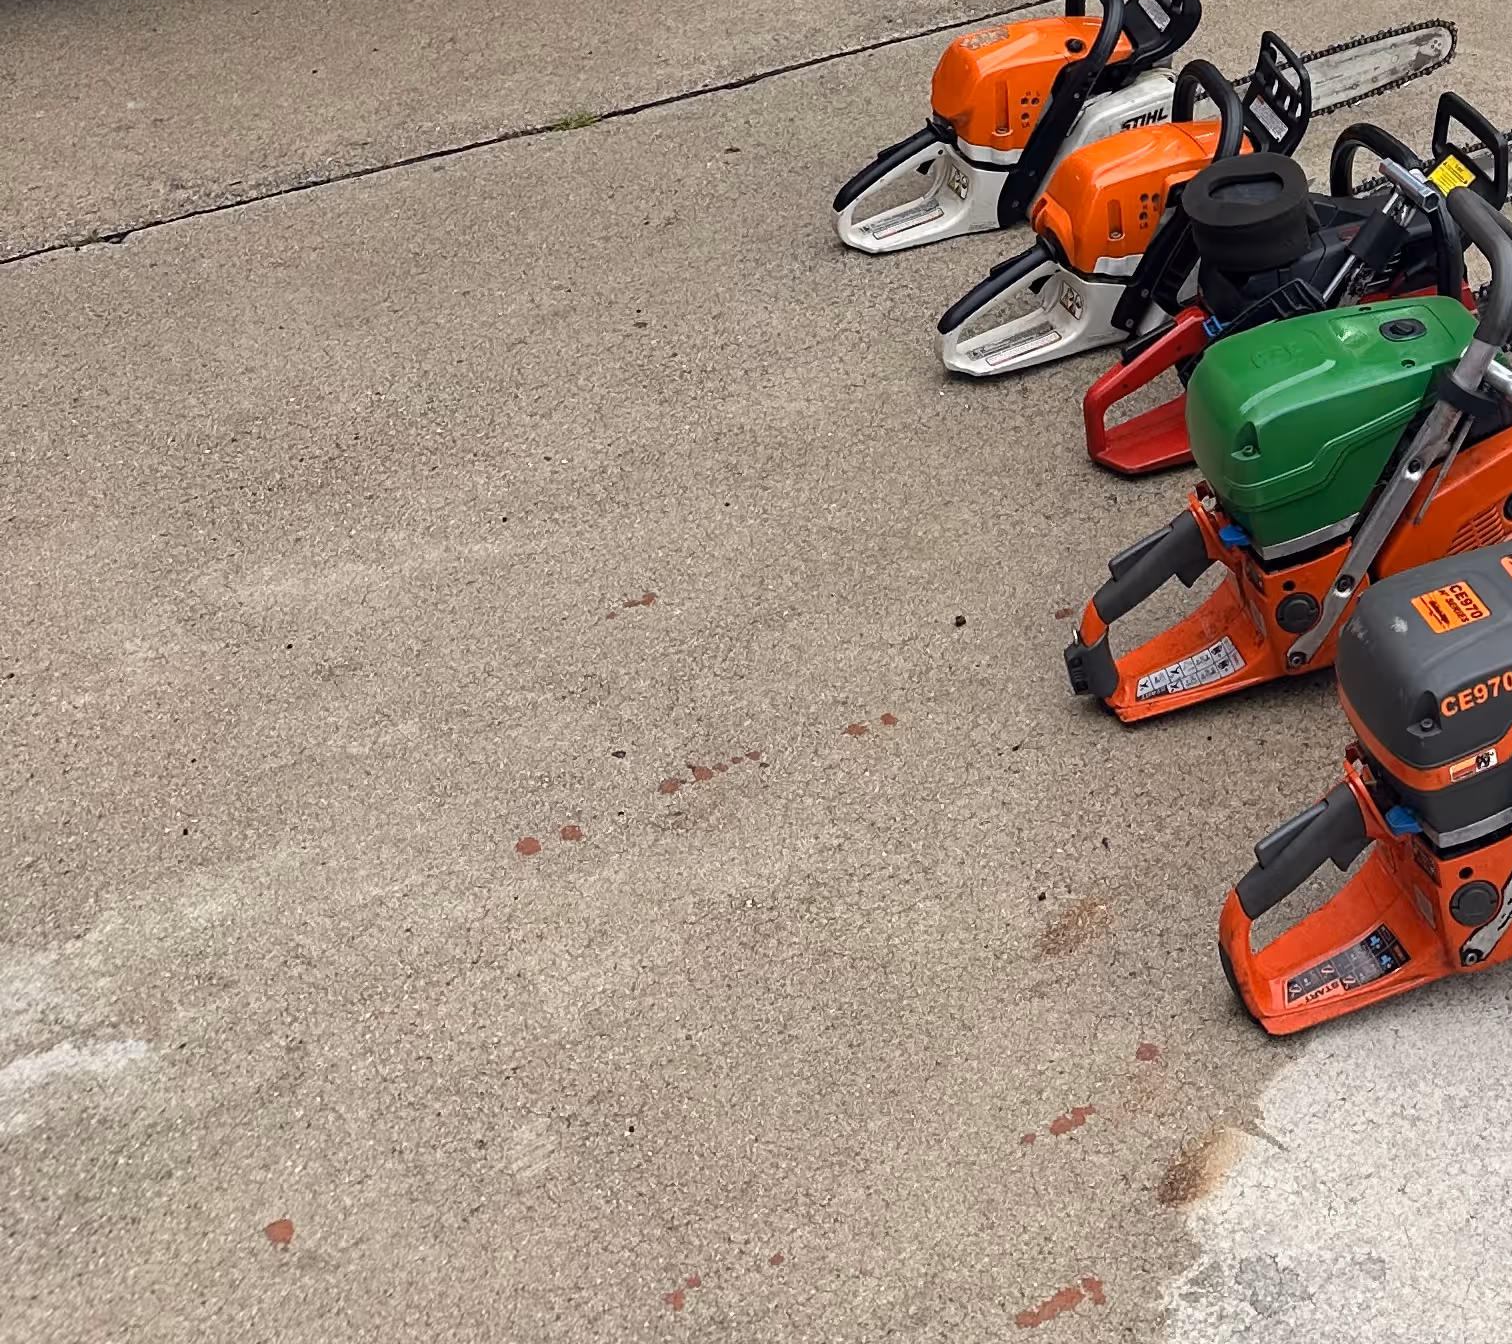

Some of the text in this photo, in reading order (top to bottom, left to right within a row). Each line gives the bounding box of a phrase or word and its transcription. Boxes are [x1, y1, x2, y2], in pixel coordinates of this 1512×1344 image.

[1121, 107, 1168, 130] STIHL
[1449, 584, 1484, 619] CE970
[1304, 981, 1340, 1004] START
